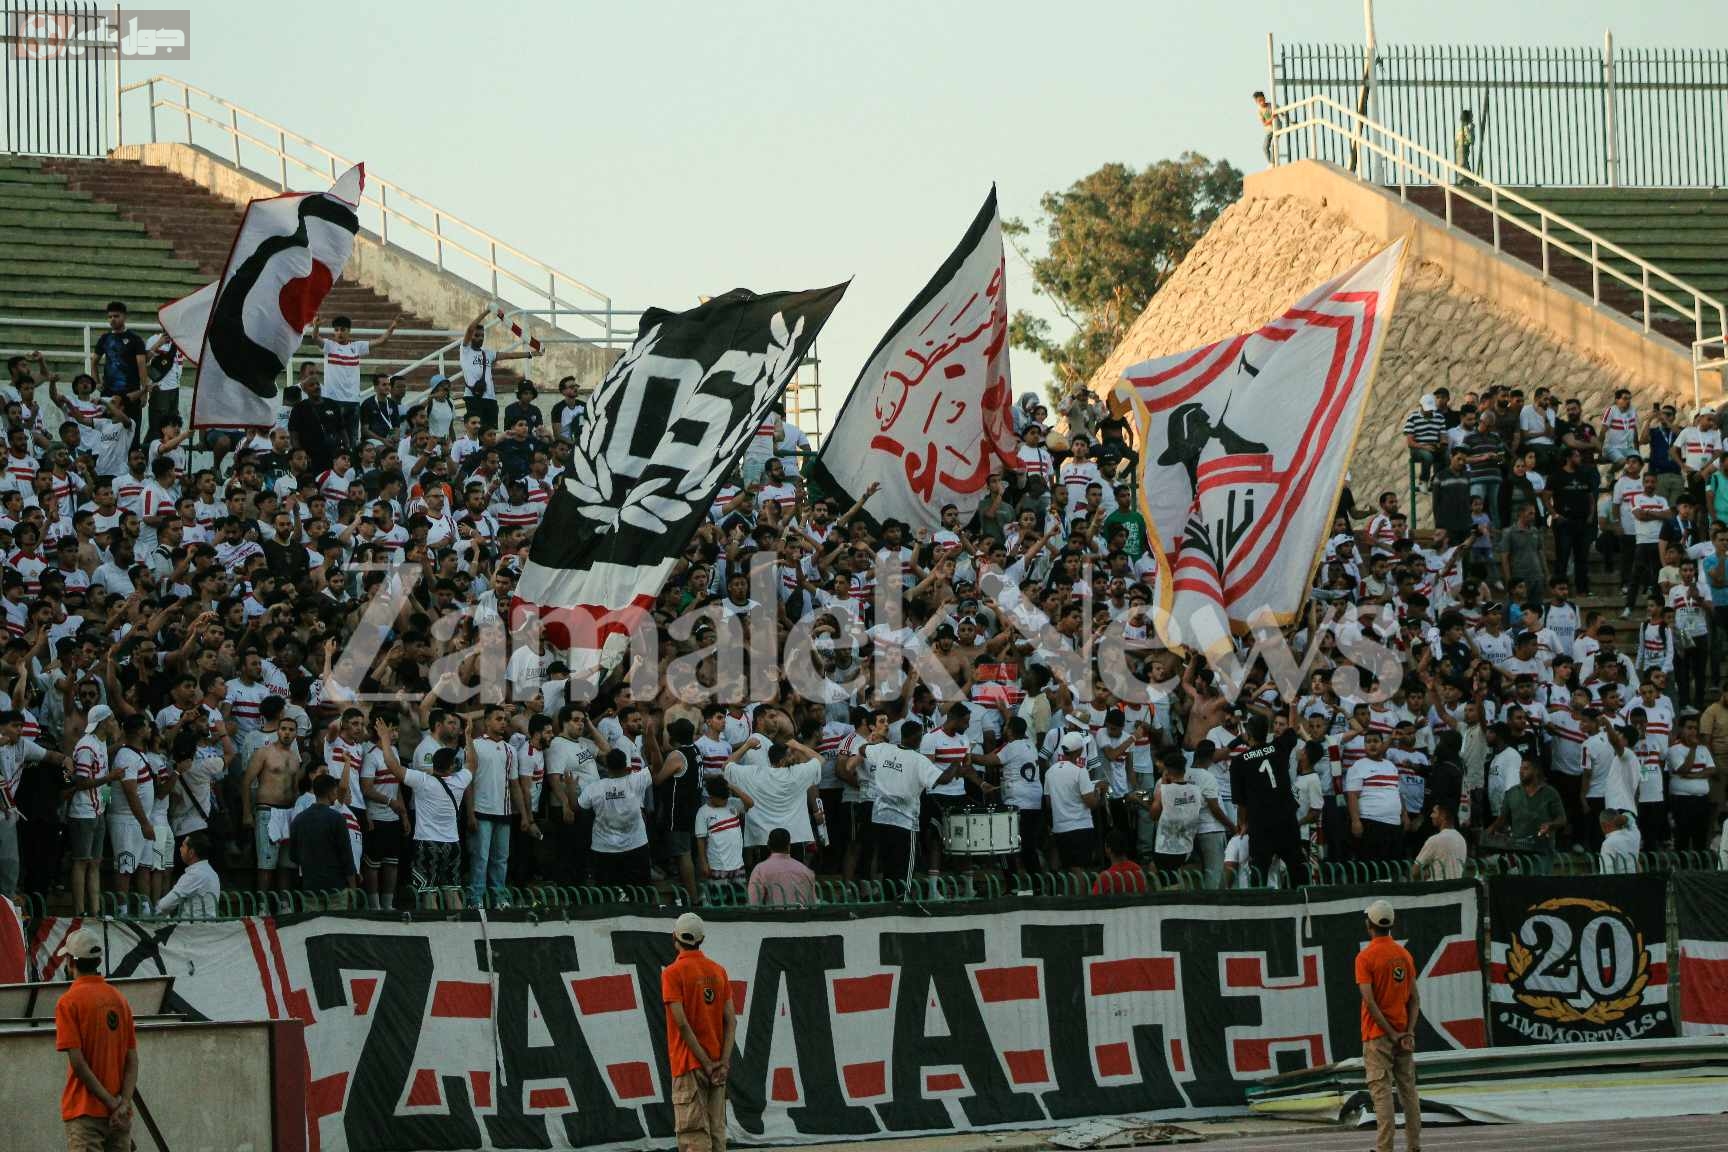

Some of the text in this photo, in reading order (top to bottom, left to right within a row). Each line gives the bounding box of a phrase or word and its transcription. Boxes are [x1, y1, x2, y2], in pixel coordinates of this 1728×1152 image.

[606, 350, 767, 479] 06
[1258, 759, 1277, 788] 1
[1519, 914, 1634, 996] 20
[306, 904, 1461, 1151] ZAMALEK
[1507, 1012, 1657, 1044] IMMORTALS
